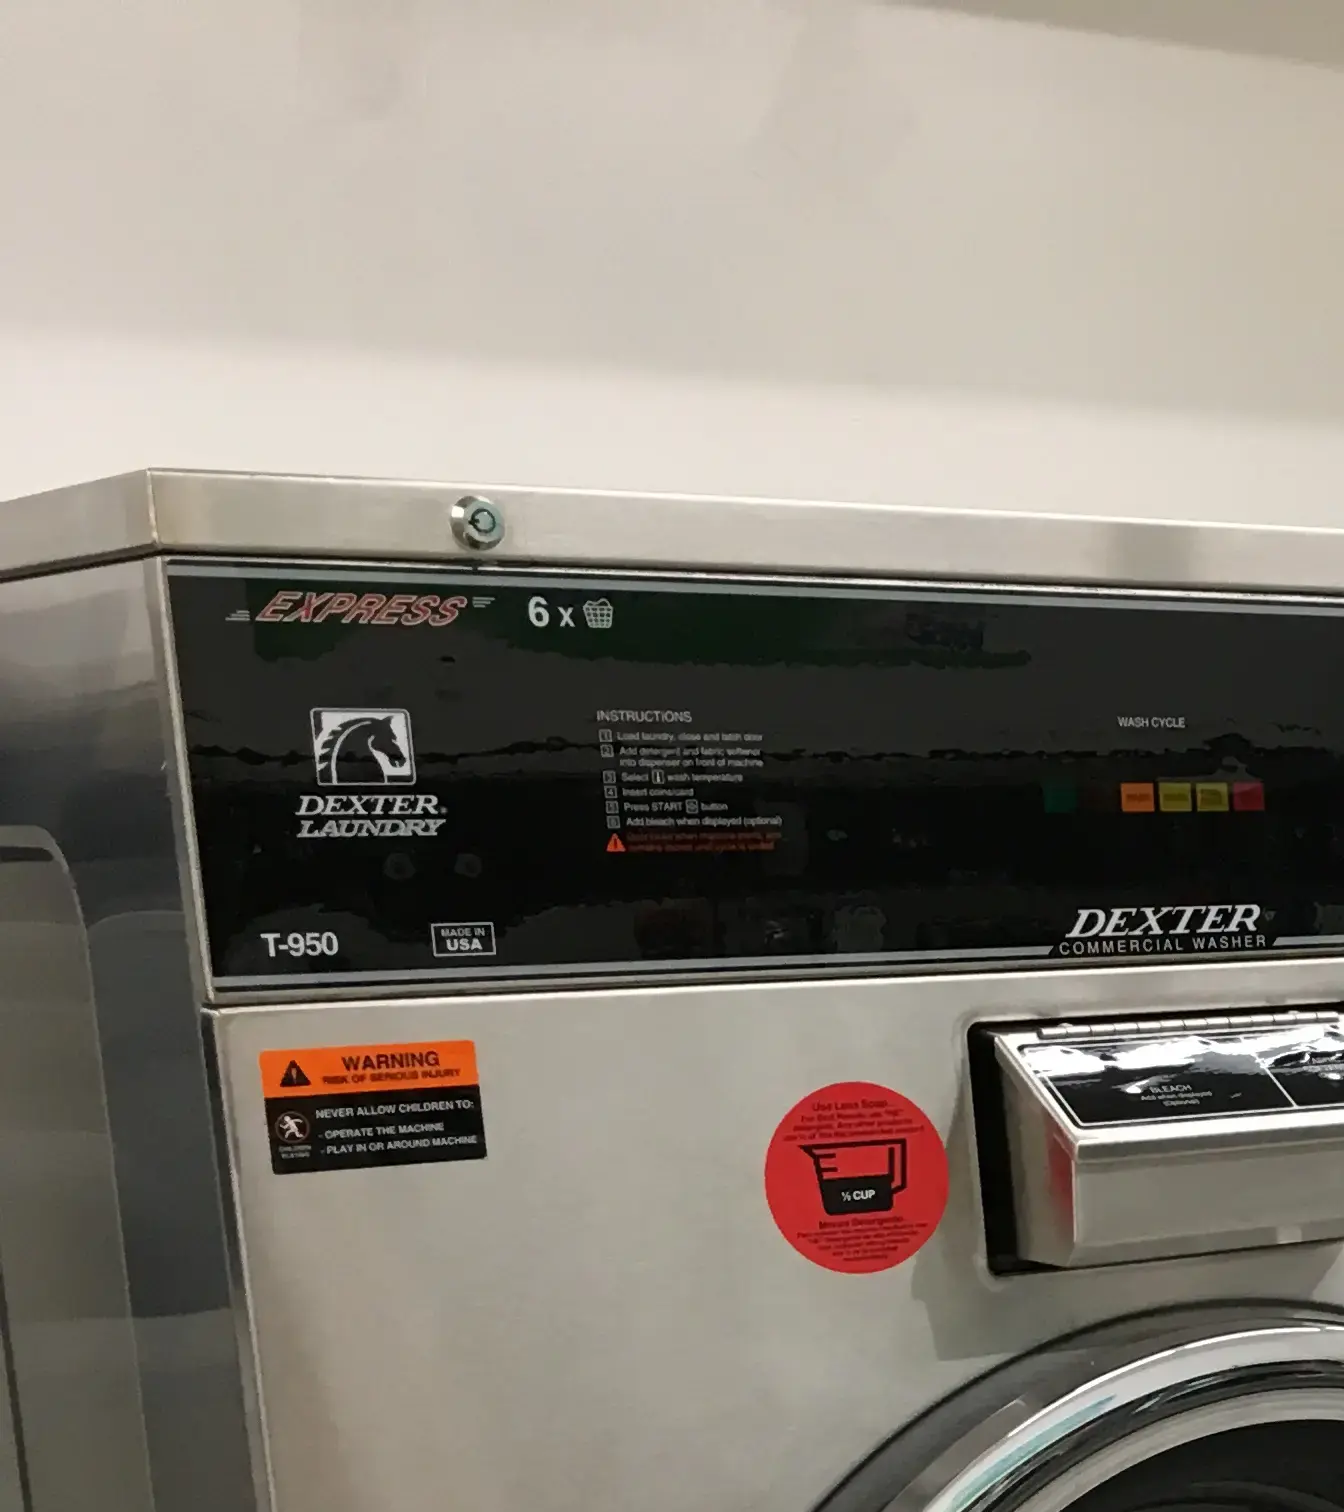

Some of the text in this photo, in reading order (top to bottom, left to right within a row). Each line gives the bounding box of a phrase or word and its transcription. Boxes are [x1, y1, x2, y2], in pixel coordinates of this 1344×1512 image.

[255, 591, 467, 626] EXPRESS
[528, 596, 576, 628] 6 x
[596, 710, 692, 723] INSTRUCTIONS
[1118, 716, 1186, 728] WASH CYCLE
[619, 747, 637, 756] Add
[683, 747, 699, 755] and
[728, 759, 764, 767] machine
[295, 795, 439, 815] DEXTER
[624, 803, 649, 811] Press
[652, 802, 683, 811] START
[296, 818, 446, 838] LAUNDRY
[626, 818, 644, 826] Add
[1065, 904, 1261, 938] DEXTER
[441, 927, 485, 937] MADE IN
[260, 932, 339, 957] T-950
[446, 938, 483, 951] USA
[1059, 935, 1266, 955] COMMERCIAL WASHER
[341, 1051, 440, 1071] WARNING
[352, 1074, 367, 1083] OF
[1149, 1084, 1192, 1092] BLEACH
[316, 1099, 474, 1119] NEVER ALLOW CHILDREN TO:
[325, 1122, 445, 1139] OPERATE THE MACHINE
[326, 1135, 477, 1155] PLAY IN OR AROUND MACHINE
[852, 1189, 875, 1200] CUP
